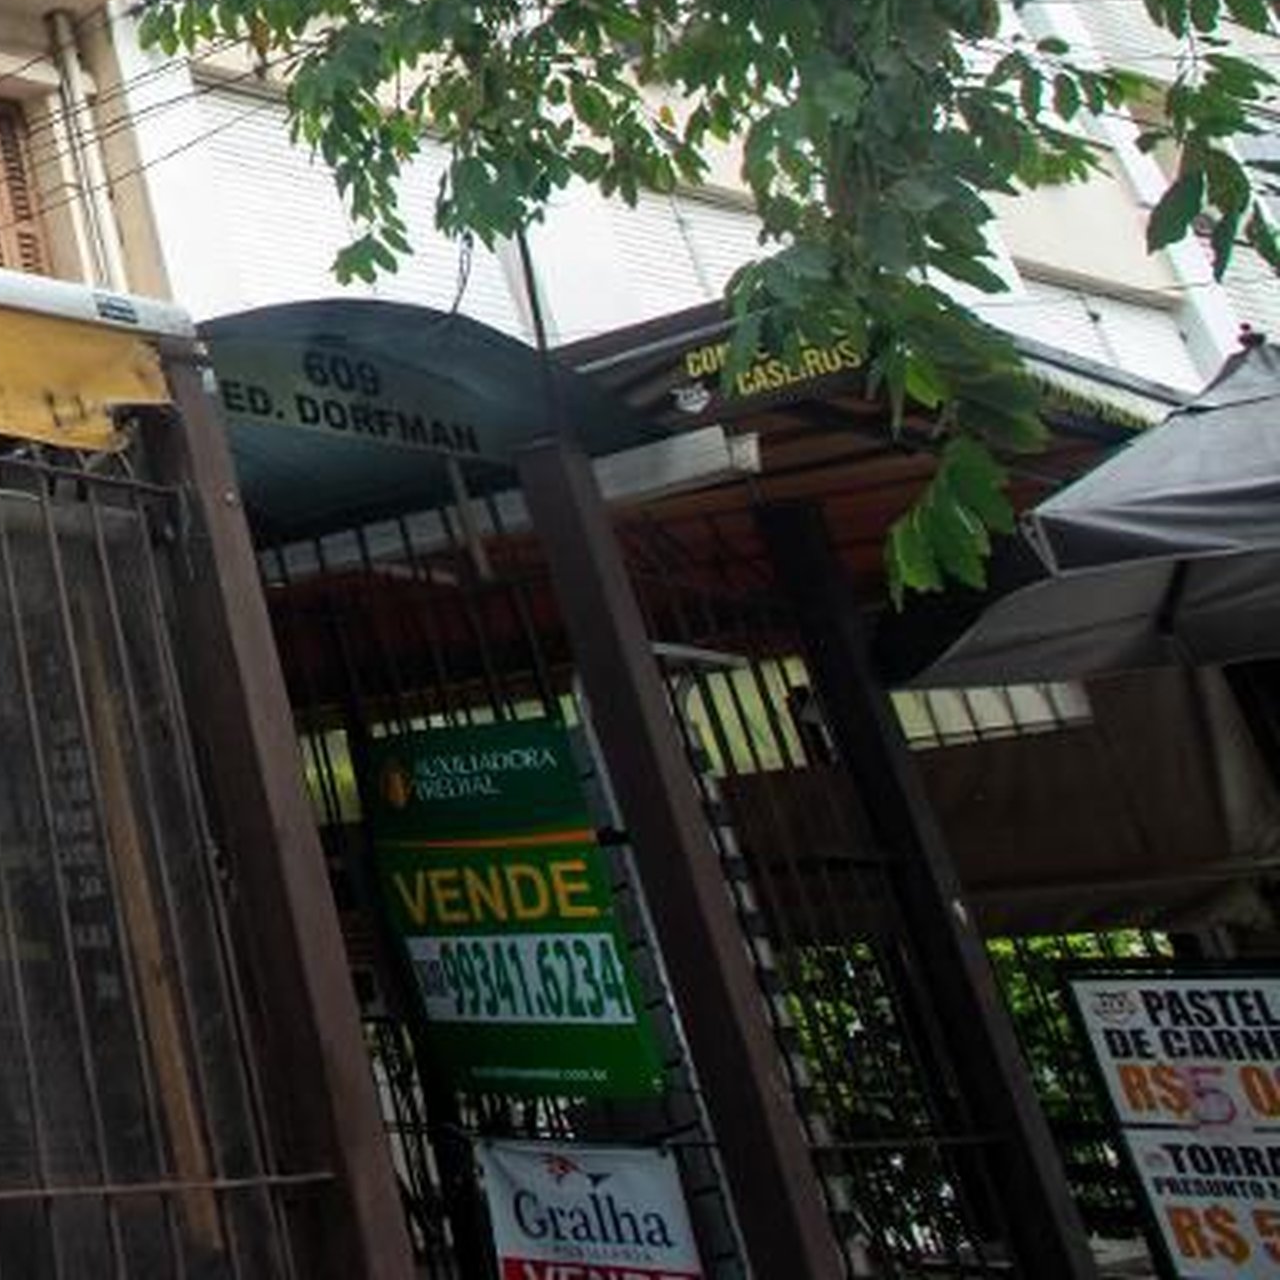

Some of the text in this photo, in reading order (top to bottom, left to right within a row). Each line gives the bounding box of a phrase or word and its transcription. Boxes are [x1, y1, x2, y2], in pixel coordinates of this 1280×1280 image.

[306, 352, 380, 394] 609
[223, 381, 479, 454] ED. DORFMAN
[394, 859, 601, 925] VENDE
[1138, 990, 1280, 1027] PASTEL
[1102, 1029, 1157, 1059] DE
[513, 1190, 672, 1248] Gralha
